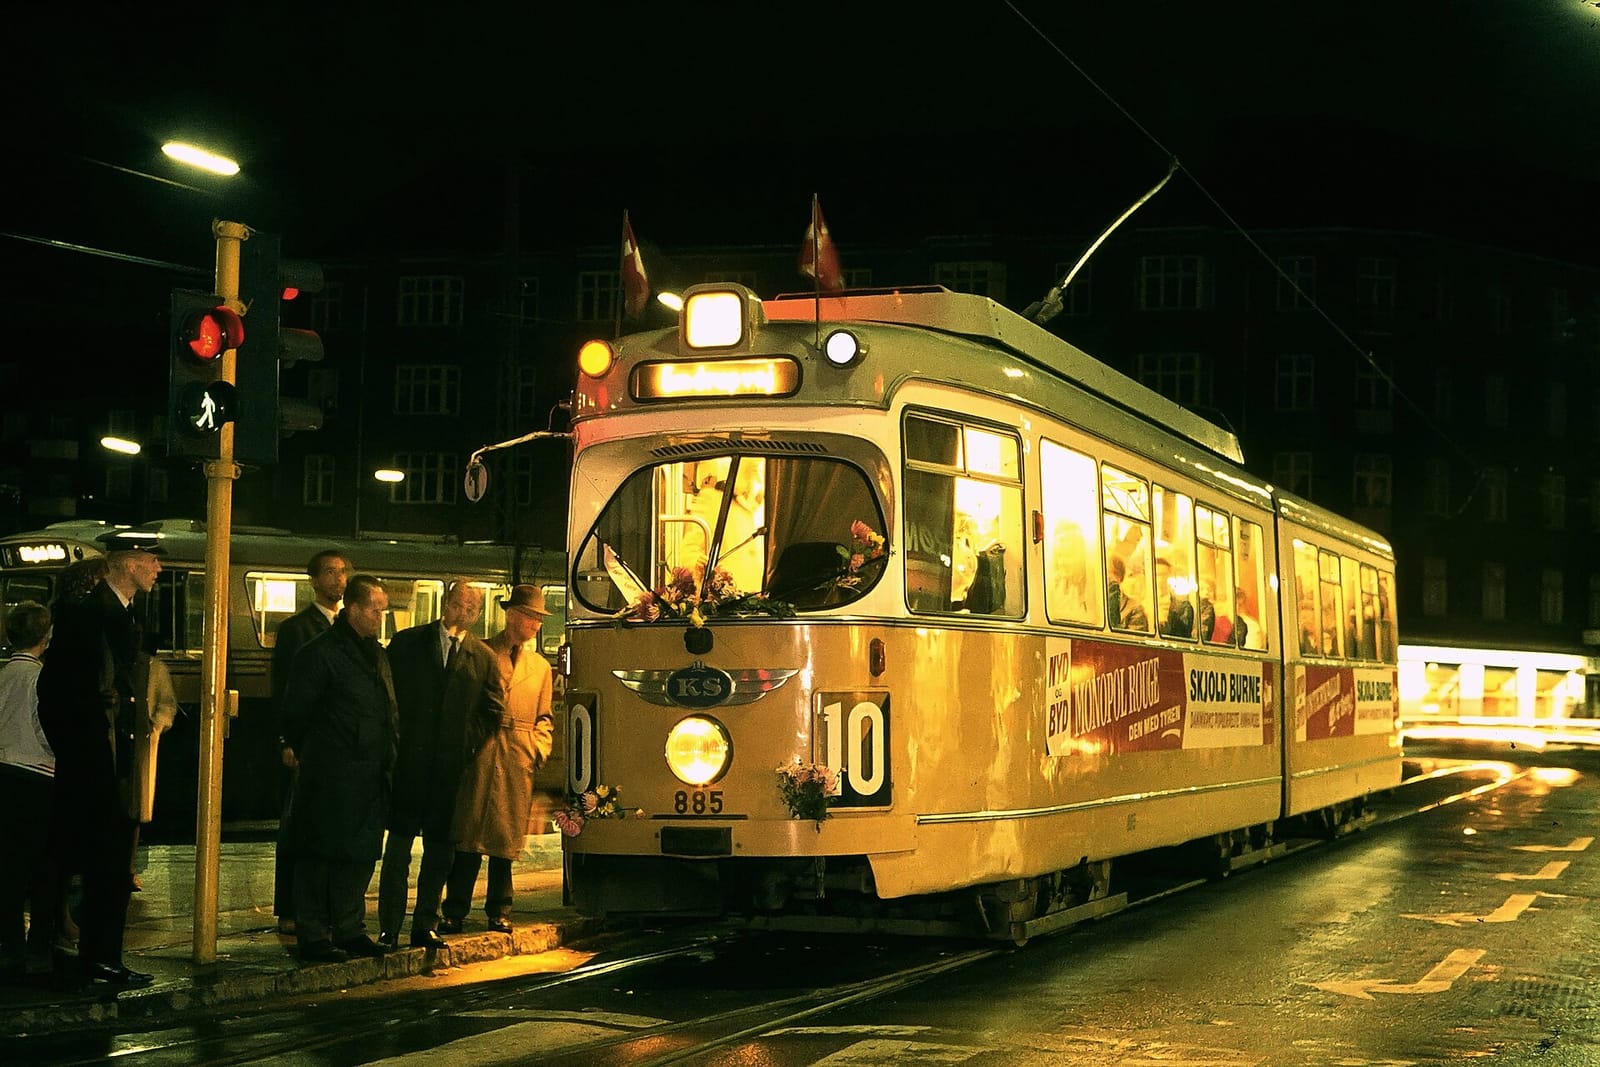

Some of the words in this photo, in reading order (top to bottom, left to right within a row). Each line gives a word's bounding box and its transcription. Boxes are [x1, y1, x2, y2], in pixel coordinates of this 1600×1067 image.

[677, 677, 722, 697] KS
[1048, 652, 1069, 688] NYD
[1190, 668, 1227, 703] SKJOLD
[1230, 673, 1261, 704] BURNE
[1073, 667, 1128, 738] MONOPOL
[1128, 657, 1160, 714] ROUGE
[1048, 699, 1069, 738] BYD
[823, 700, 885, 796] 10
[674, 790, 724, 815] 885
